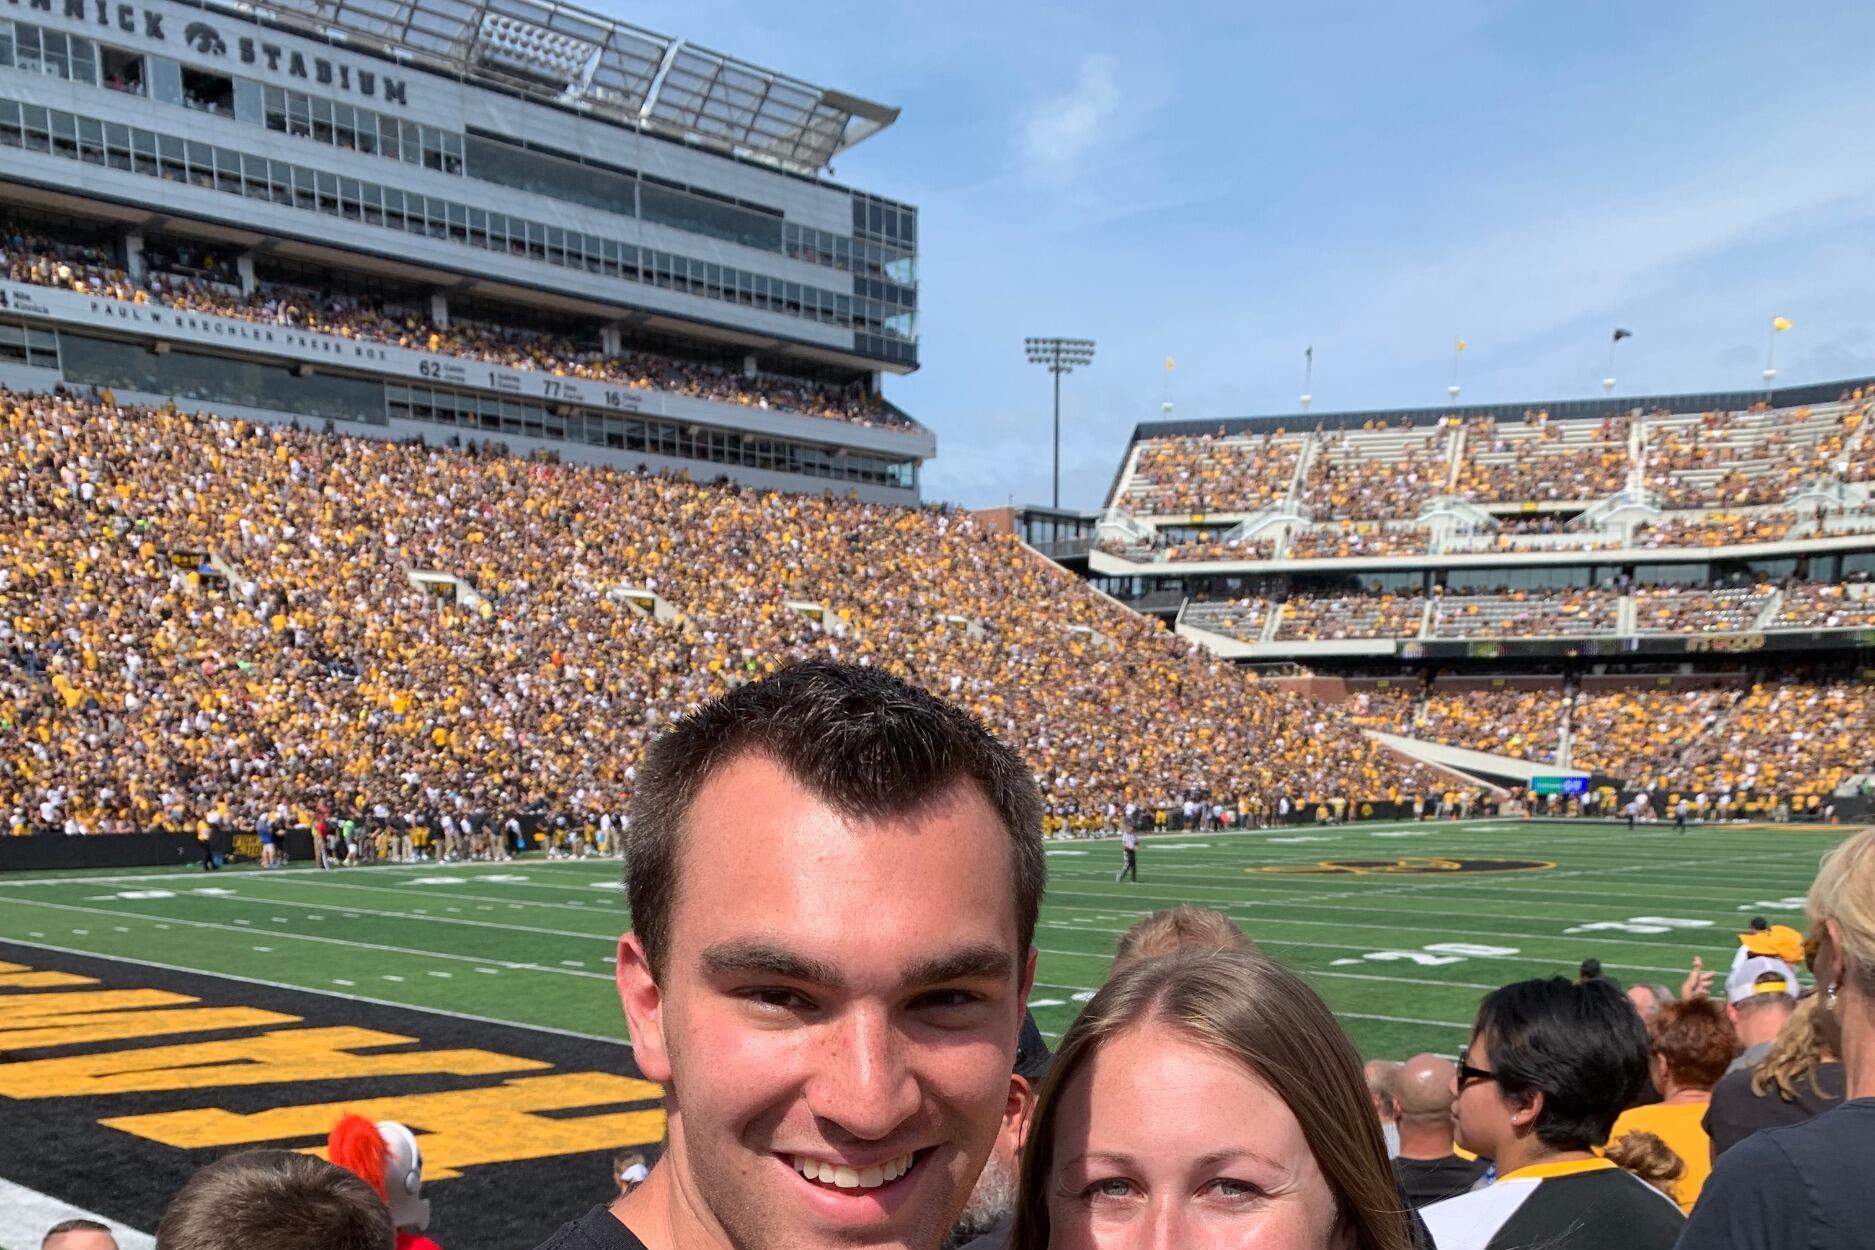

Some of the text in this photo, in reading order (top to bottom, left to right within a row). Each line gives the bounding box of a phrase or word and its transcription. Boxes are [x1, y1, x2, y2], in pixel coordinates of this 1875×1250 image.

[239, 36, 407, 106] STADIUM
[419, 360, 441, 378] 62
[488, 372, 495, 387] 1
[542, 380, 561, 396] 77
[605, 391, 621, 407] 16
